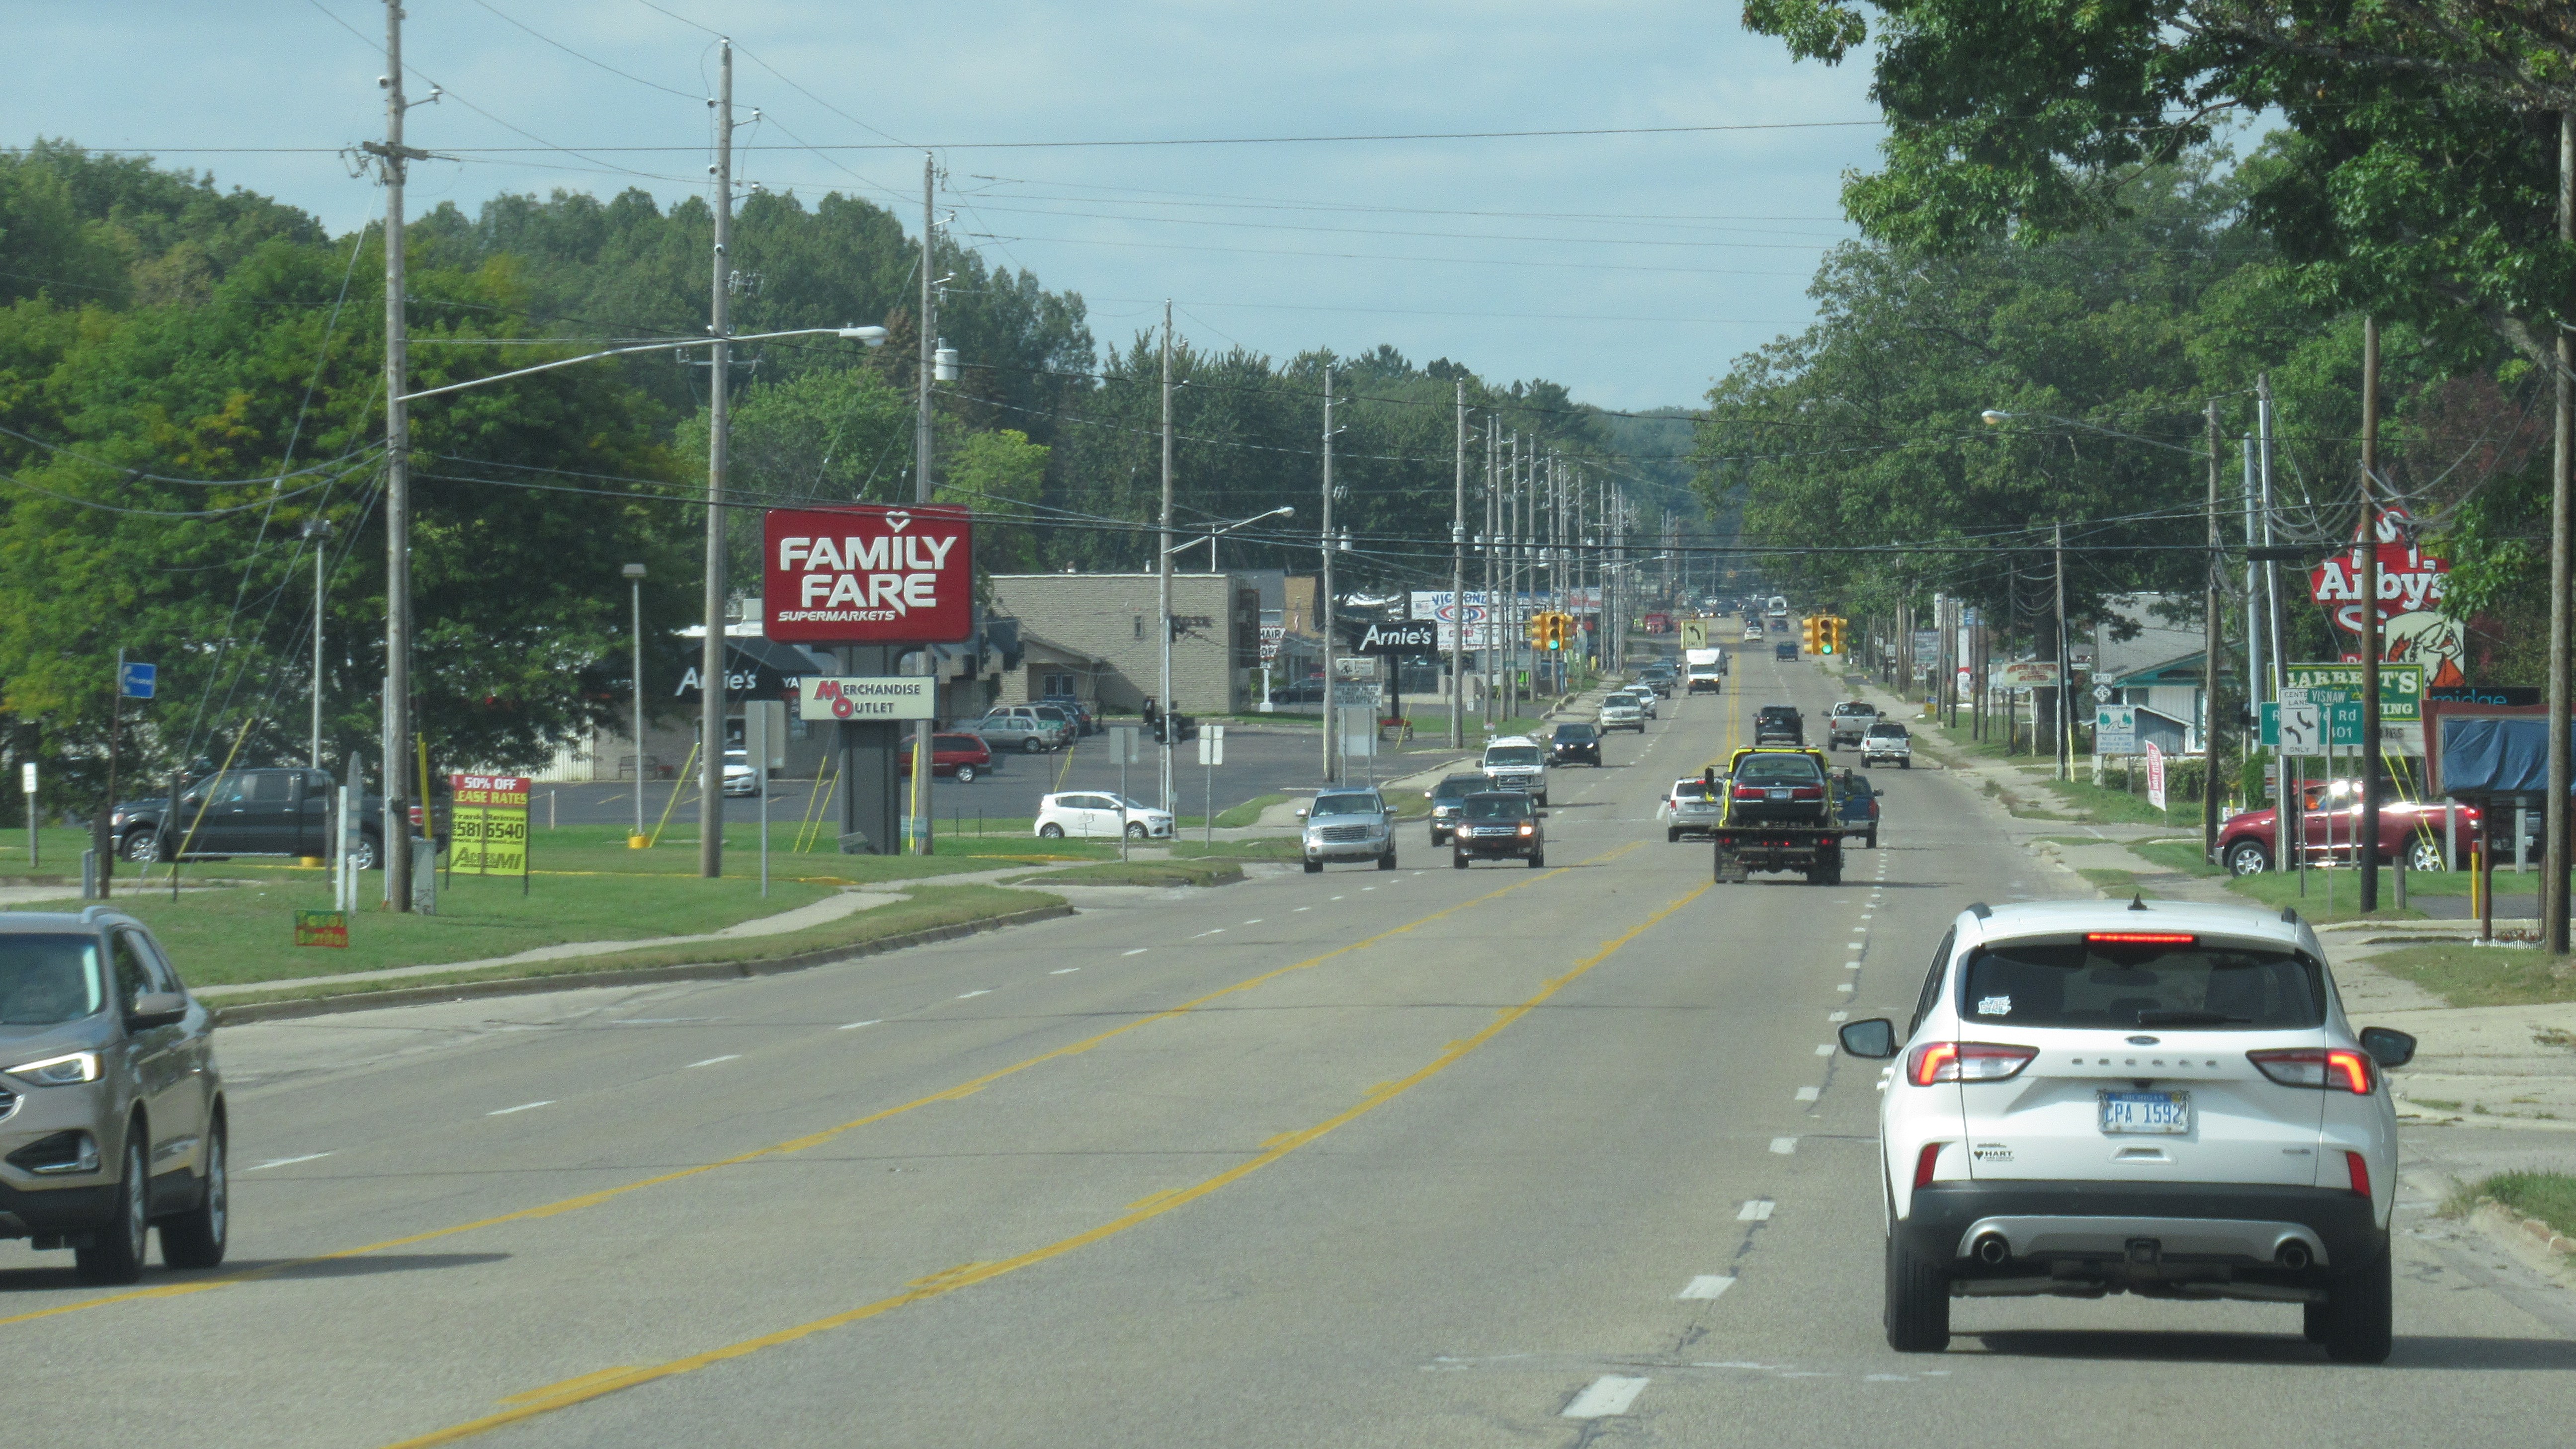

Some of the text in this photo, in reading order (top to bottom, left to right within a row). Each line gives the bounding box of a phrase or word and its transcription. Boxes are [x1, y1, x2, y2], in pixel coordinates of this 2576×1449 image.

[780, 536, 957, 571] FAMILY
[802, 573, 936, 617] FARE
[777, 610, 896, 622] SUPERMARKETS
[1359, 625, 1431, 651] Arnie's
[814, 680, 920, 700] MERCHANDISE
[831, 696, 894, 718] OUTLET
[2338, 710, 2356, 721] Rd
[464, 776, 517, 790] 50% OFF
[491, 792, 528, 804] RATES
[457, 821, 481, 837] 581
[486, 822, 524, 839] 6540
[2143, 1103, 2182, 1124] 1592
